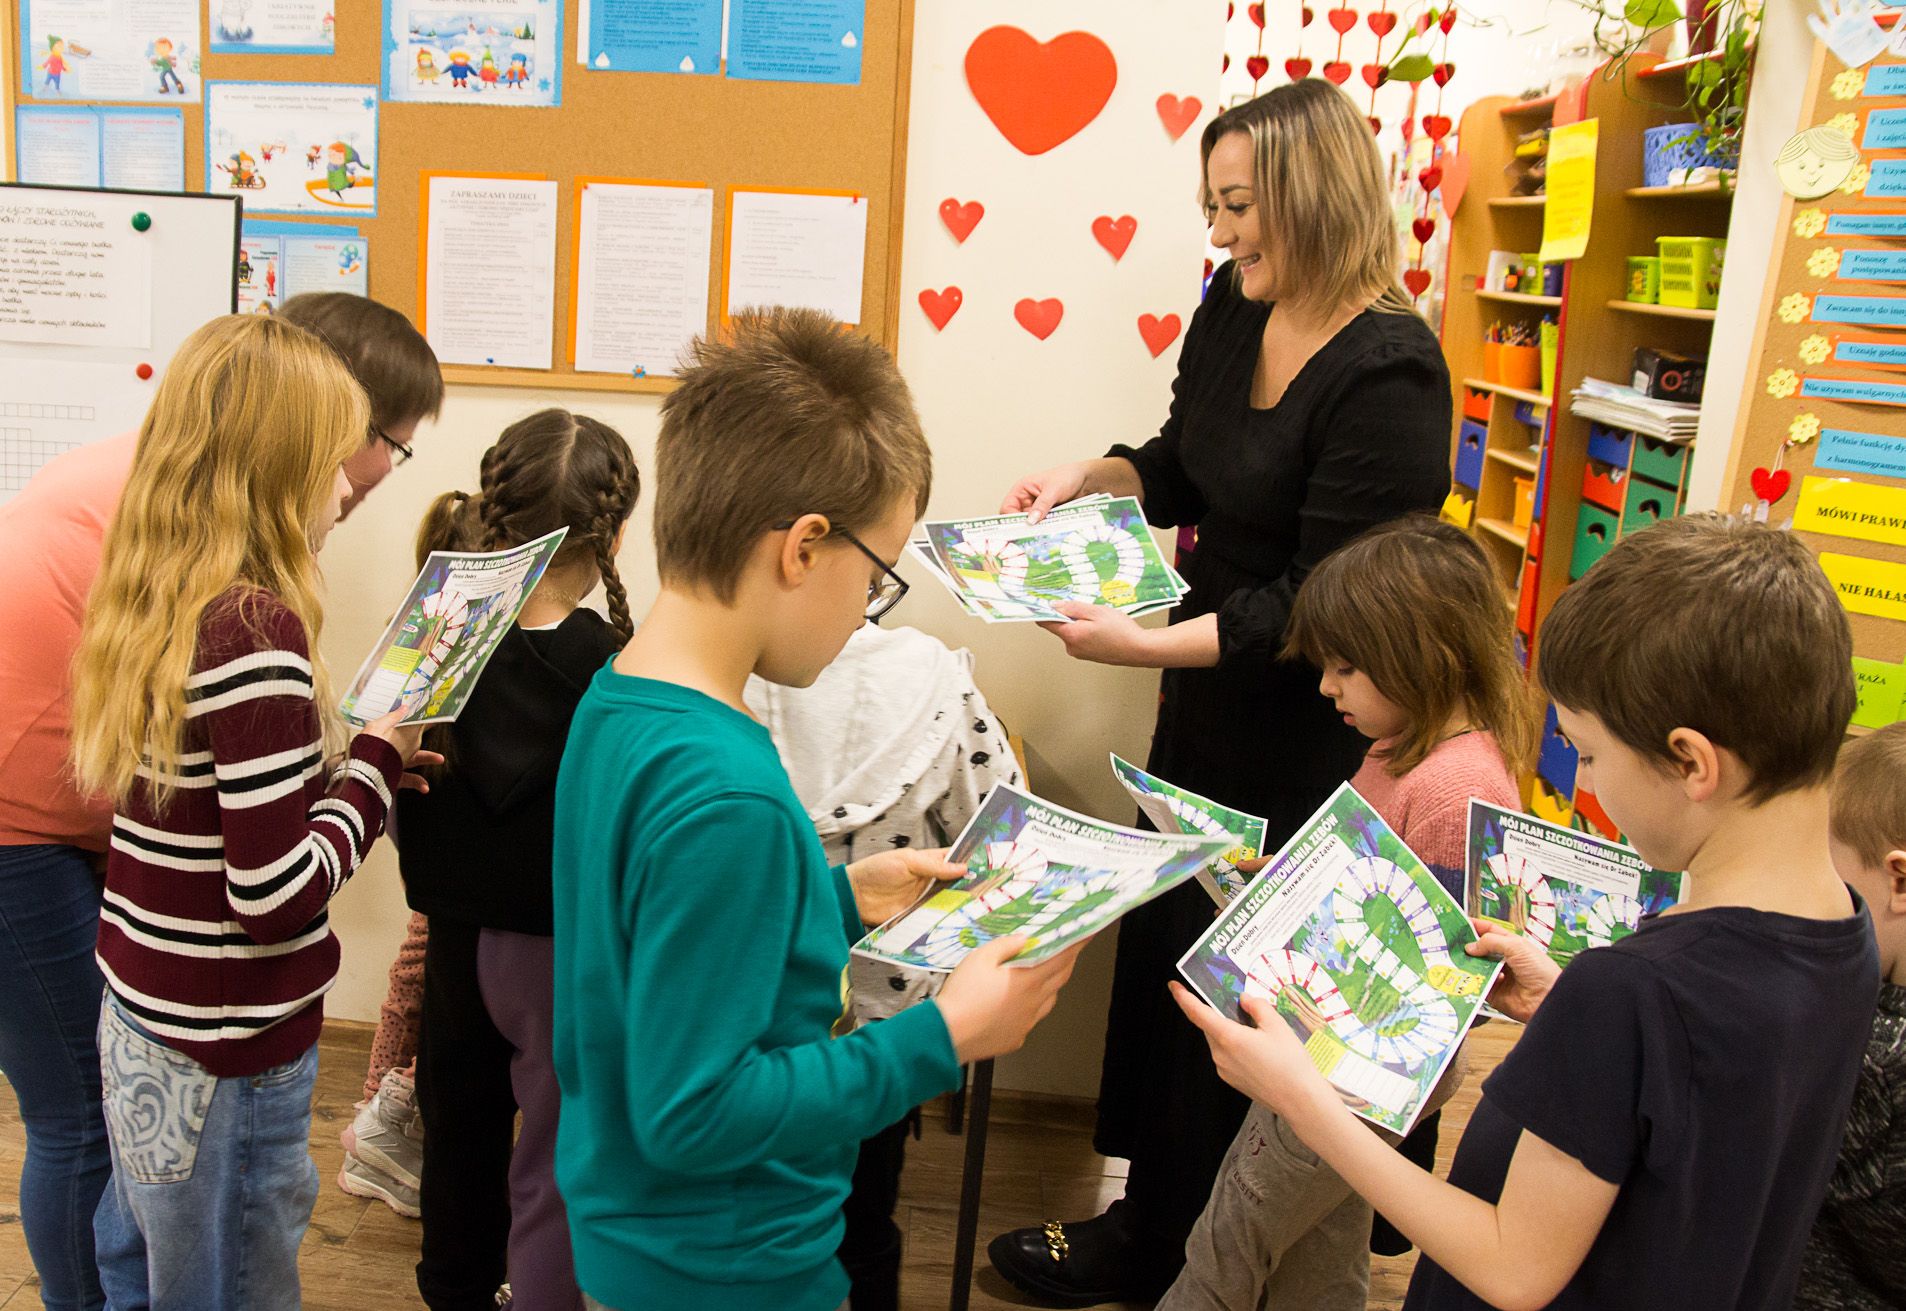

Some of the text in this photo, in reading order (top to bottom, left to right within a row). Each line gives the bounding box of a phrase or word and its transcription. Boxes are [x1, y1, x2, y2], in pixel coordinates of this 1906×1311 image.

[450, 190, 506, 199] ZAPRASZAMY
[1877, 306, 1889, 314] do
[1804, 383, 1818, 391] Nie
[1816, 506, 1858, 522] MÓWI
[448, 557, 466, 570] MÓJ
[464, 560, 484, 570] PLAN
[1838, 582, 1862, 596] NIE
[1025, 804, 1052, 823] MÓJ
[1049, 814, 1081, 834] PLAN
[1499, 814, 1519, 831] MÓJ
[1519, 821, 1544, 839] PLAN
[1545, 830, 1620, 863] SZCZOTKOWANIA
[1574, 854, 1600, 867] Nazywam
[1281, 872, 1306, 897] Nazywam
[1312, 856, 1321, 864] Dr
[1209, 931, 1231, 955] MÓJ
[1224, 908, 1250, 937] PLAN
[1245, 842, 1313, 915] SZCZOTKOWANIA
[1243, 925, 1259, 941] Dobry
